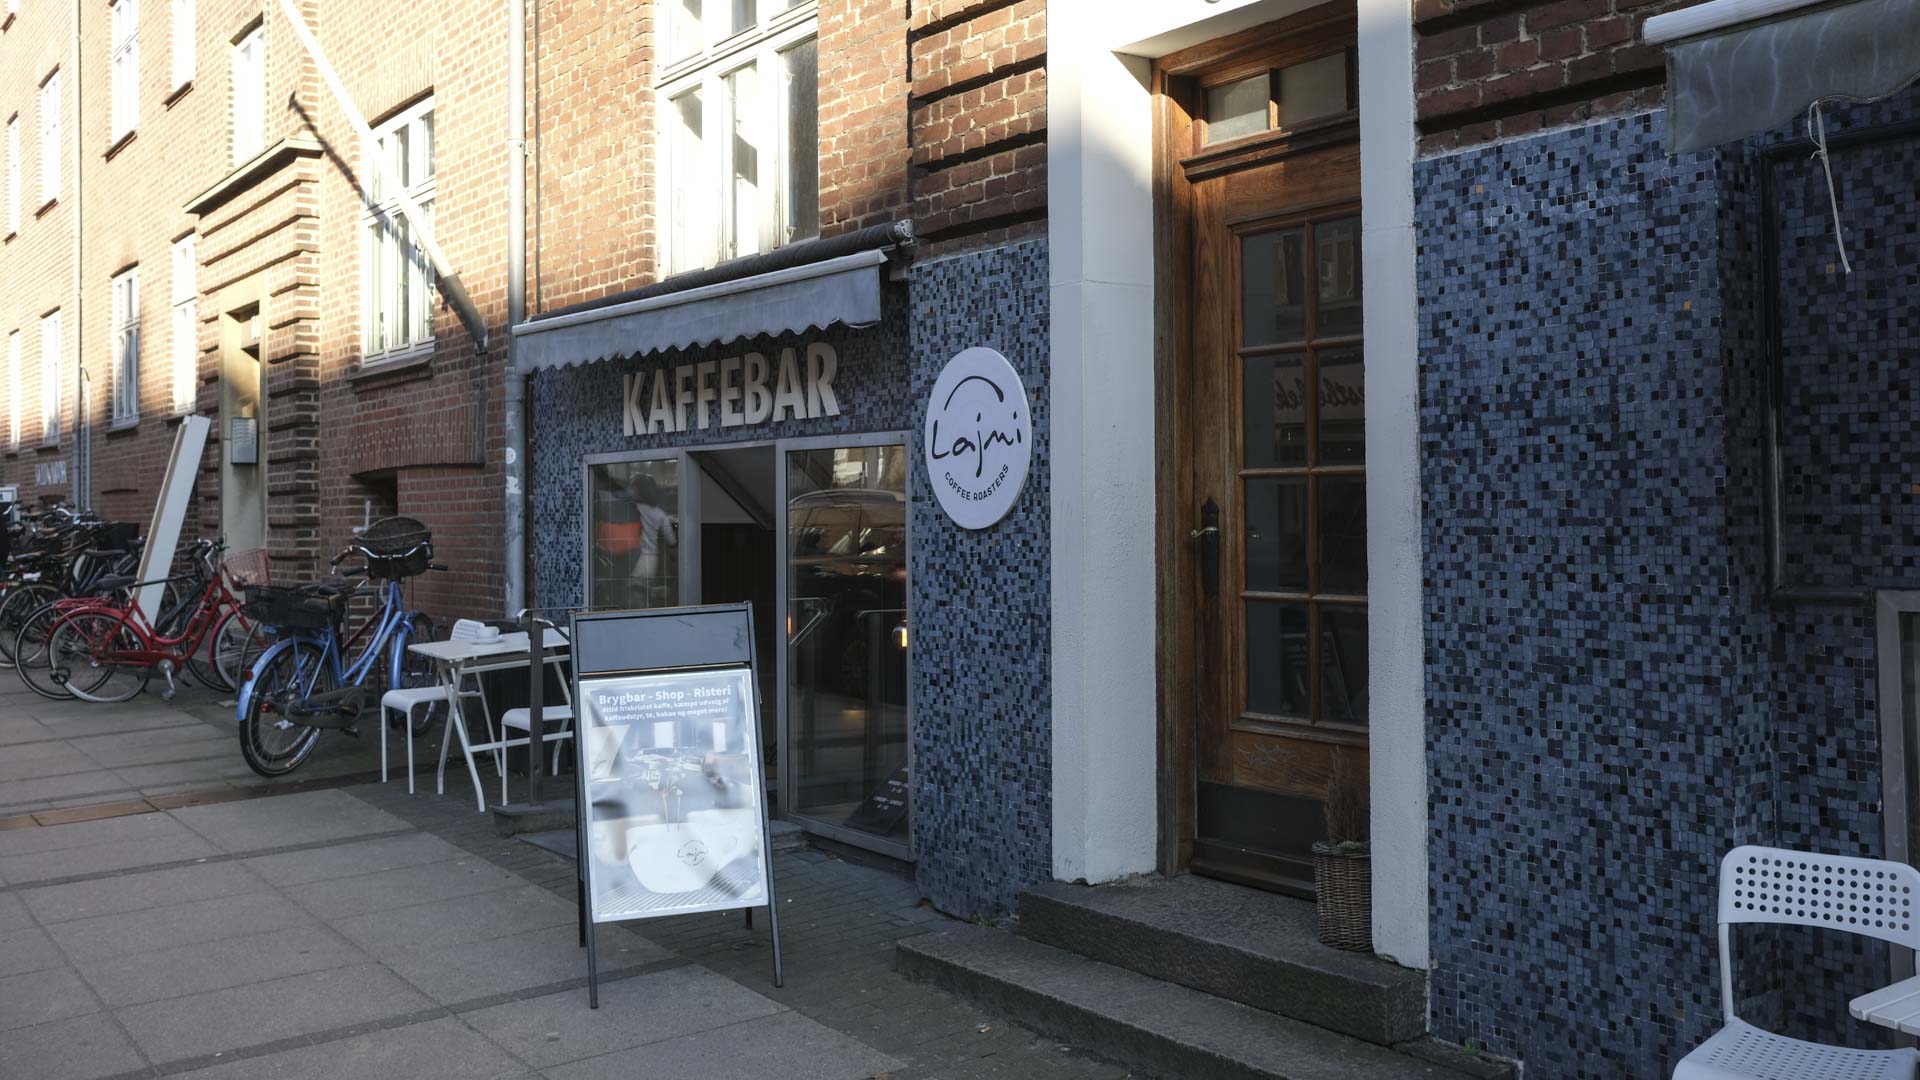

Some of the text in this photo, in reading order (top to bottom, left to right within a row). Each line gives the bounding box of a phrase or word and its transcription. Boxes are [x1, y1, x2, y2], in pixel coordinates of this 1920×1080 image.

[623, 342, 840, 437] KAFFEBAR
[931, 410, 1022, 478] Lajmi
[945, 463, 1009, 501] COFFEE ROASTERS
[599, 692, 646, 706] Brygbar
[655, 690, 684, 702] Shop
[693, 684, 731, 698] Risteri
